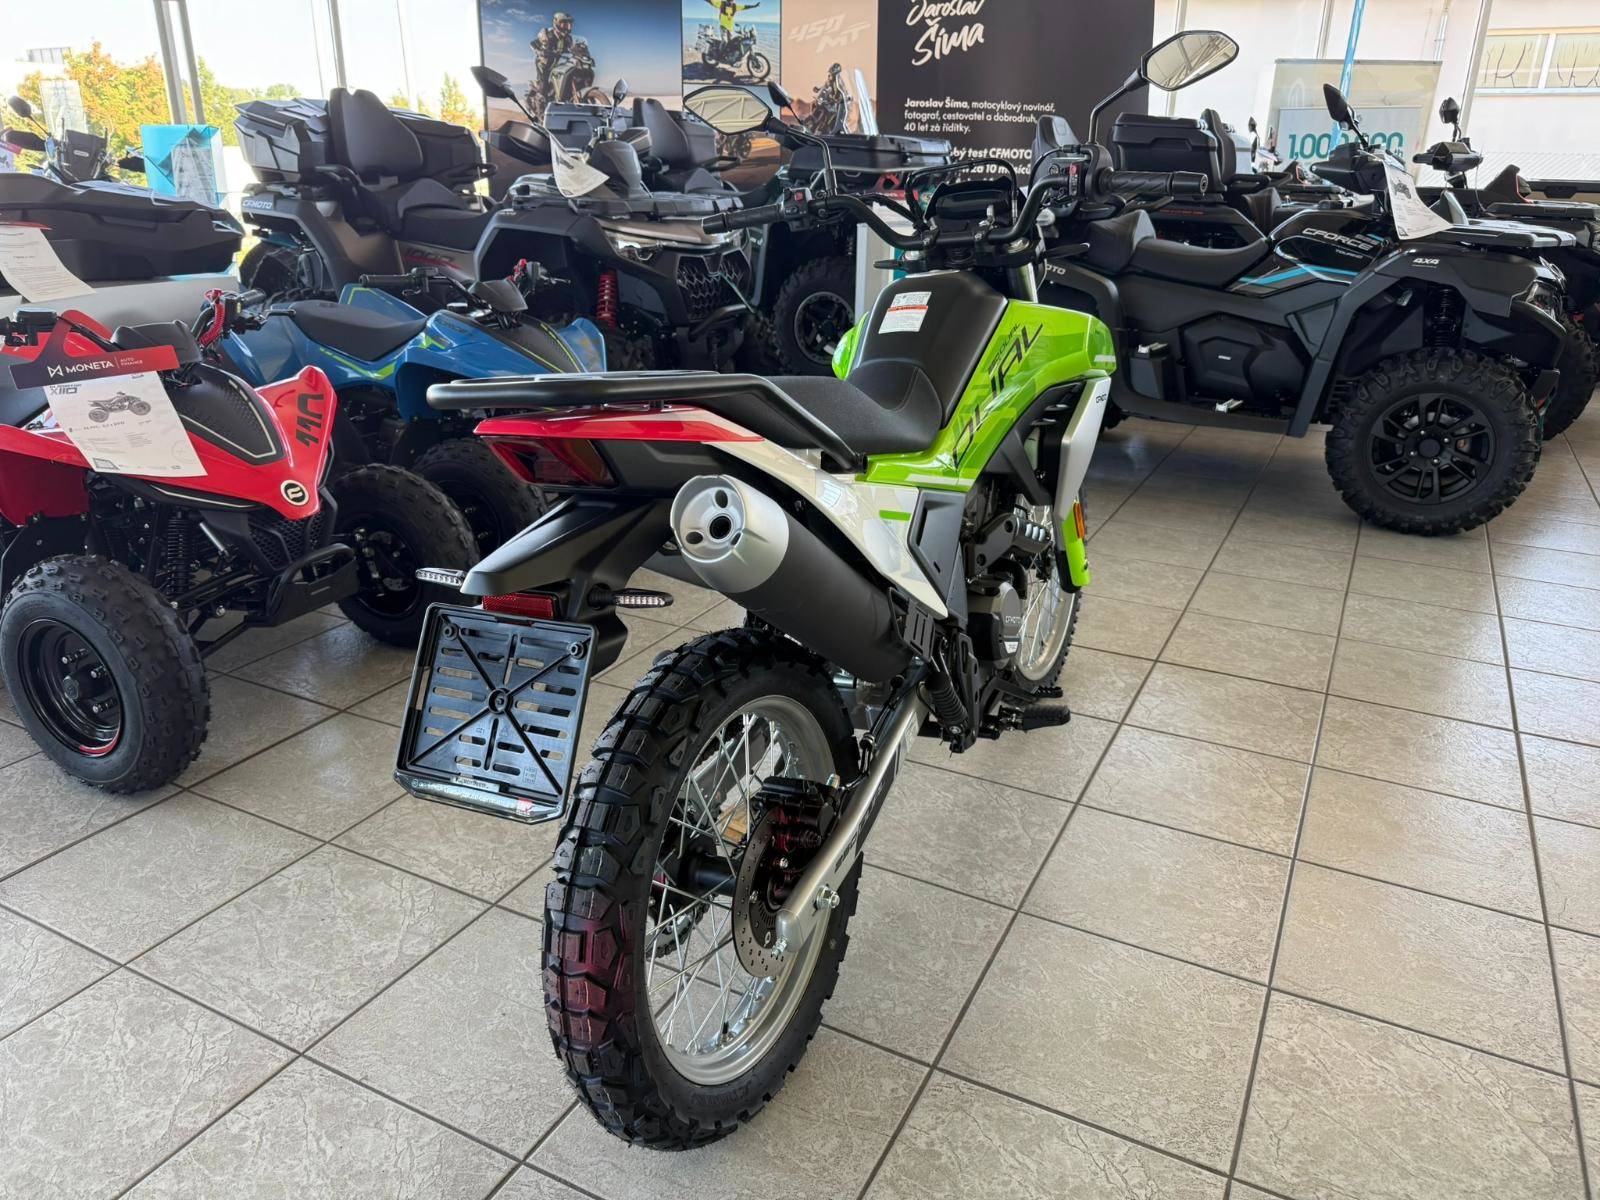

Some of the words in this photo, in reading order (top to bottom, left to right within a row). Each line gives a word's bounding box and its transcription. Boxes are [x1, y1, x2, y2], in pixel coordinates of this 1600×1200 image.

[815, 21, 871, 54] MT
[911, 17, 985, 66] Šíma
[904, 98, 943, 109] Jaroslav
[944, 97, 970, 110] Šíma,
[971, 101, 1021, 113] motocyklový
[904, 109, 941, 121] fotograf,
[942, 111, 985, 121] cestovatel
[993, 113, 1038, 124] dobrodruh,
[903, 122, 916, 132] 40
[917, 122, 929, 132] let
[967, 148, 988, 158] test
[988, 148, 1032, 160] CFMOTO
[985, 164, 997, 174] 10
[997, 163, 1032, 175] msíců
[1301, 227, 1374, 252] CFORCE
[65, 360, 115, 375] MONETA
